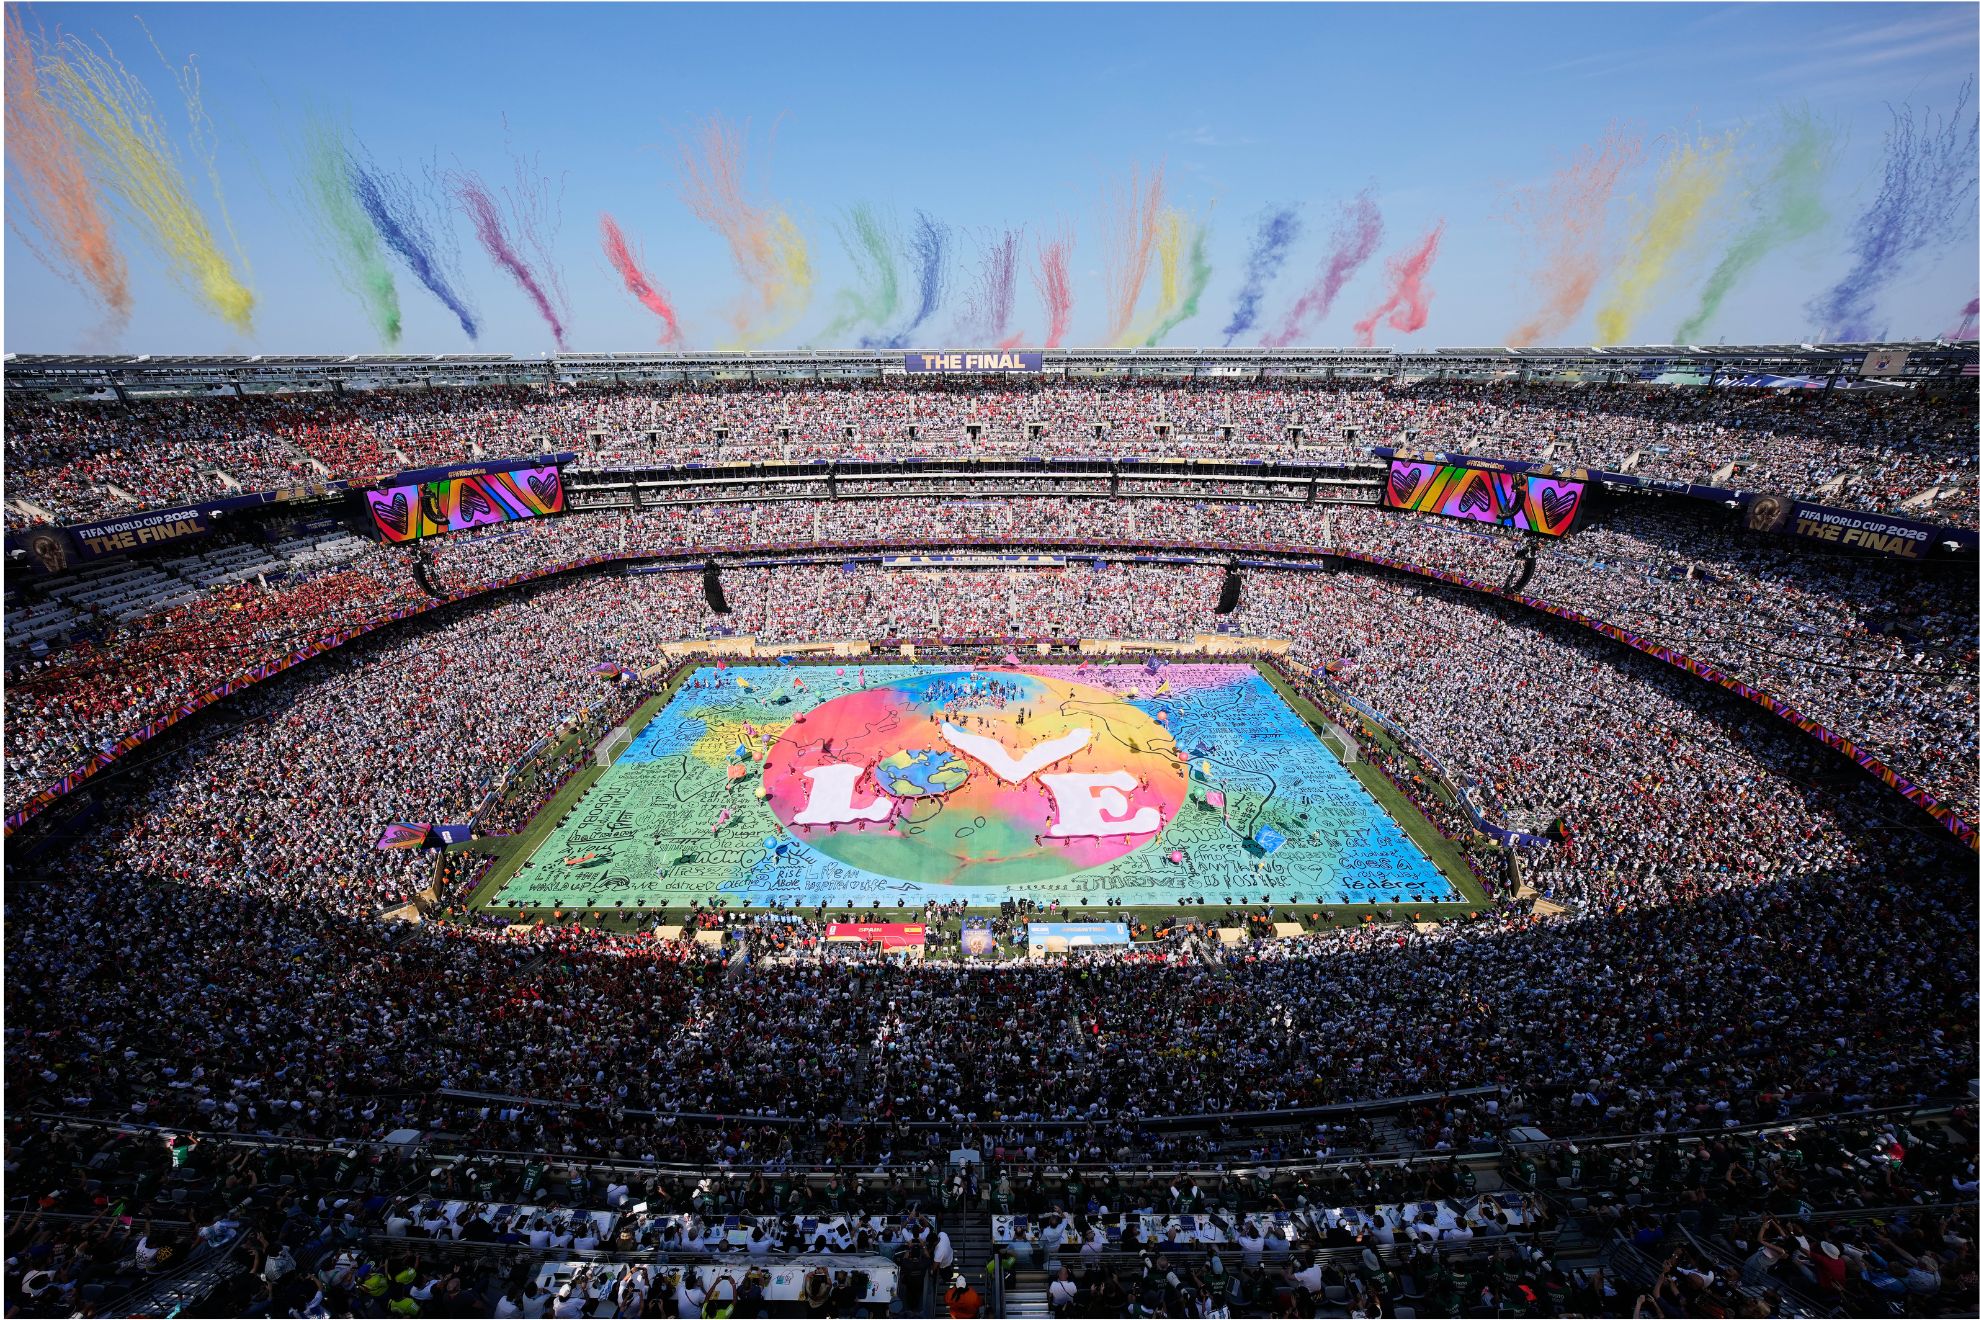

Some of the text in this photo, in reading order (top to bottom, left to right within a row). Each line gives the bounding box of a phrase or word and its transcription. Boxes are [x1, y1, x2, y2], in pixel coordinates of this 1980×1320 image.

[921, 354, 1026, 369] THE FINAL
[79, 510, 199, 539] FIFA WORLD CUP 2026
[84, 519, 206, 554] THE FINAL
[1799, 510, 1929, 541] FIFA WORLD CUP 2026
[1796, 520, 1920, 559] THE FINAL
[1071, 875, 1187, 892] THRIVE
[1342, 876, 1427, 889] fédérer
